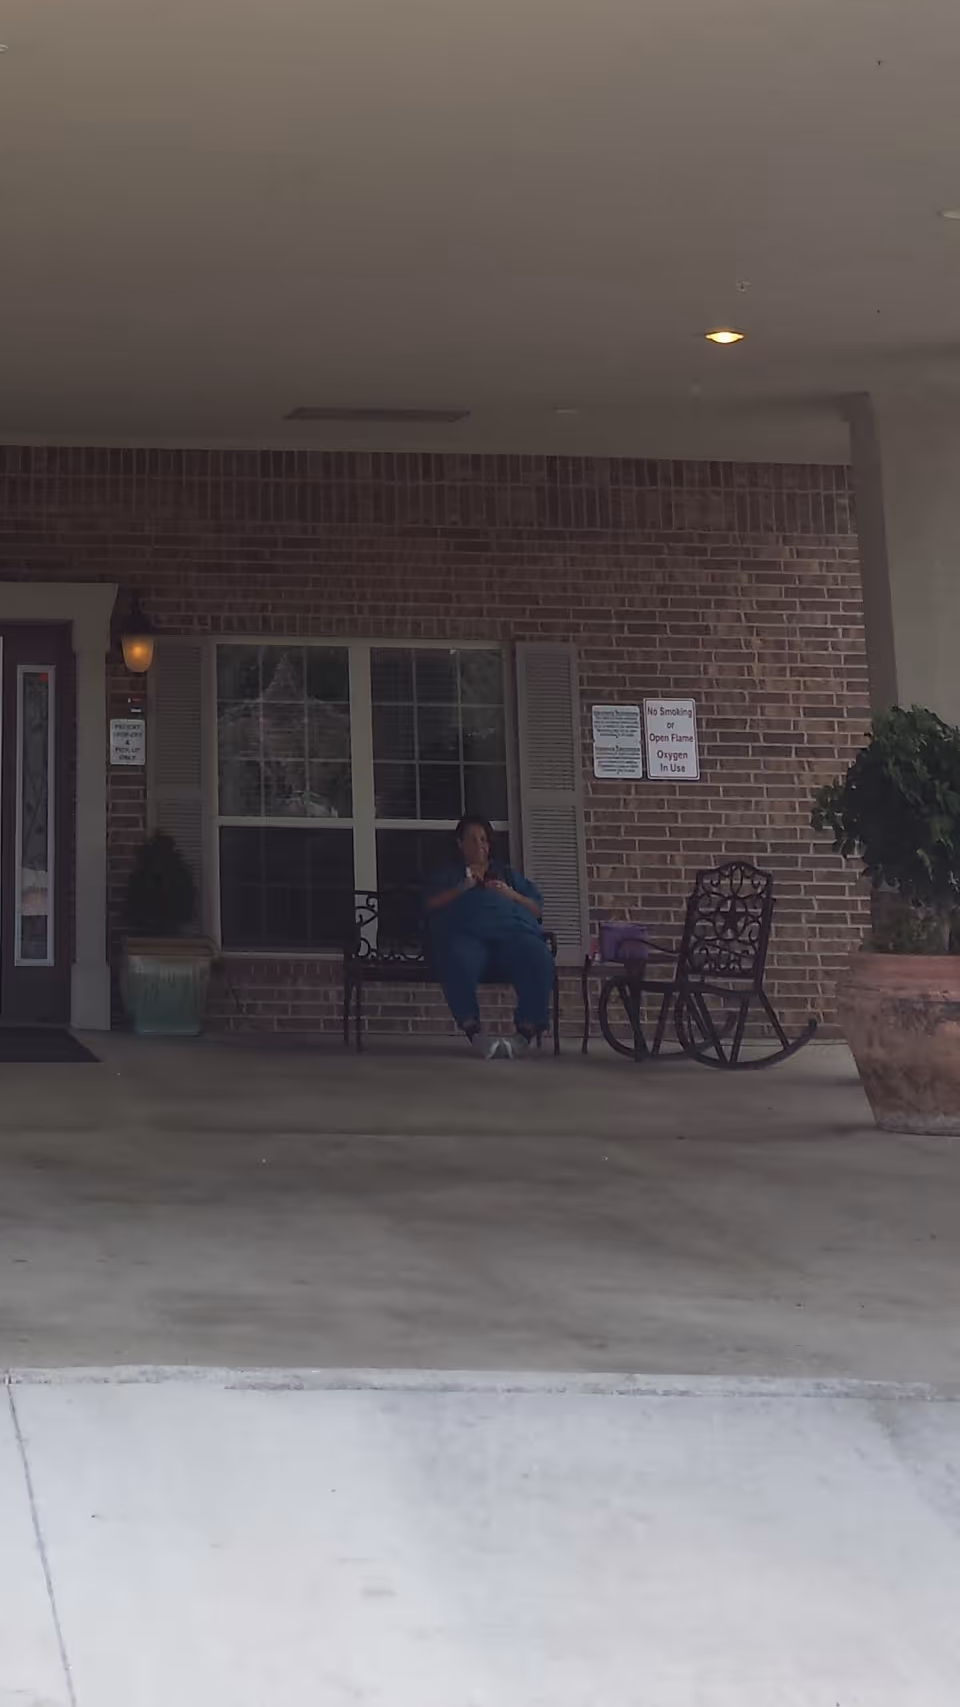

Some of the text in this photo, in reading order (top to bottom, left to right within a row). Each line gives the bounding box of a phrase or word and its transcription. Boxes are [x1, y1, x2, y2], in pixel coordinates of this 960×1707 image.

[648, 706, 692, 718] No Smoking
[650, 733, 693, 743] Open Flame
[657, 750, 688, 761] Oxygen
[661, 763, 686, 772] In Use
